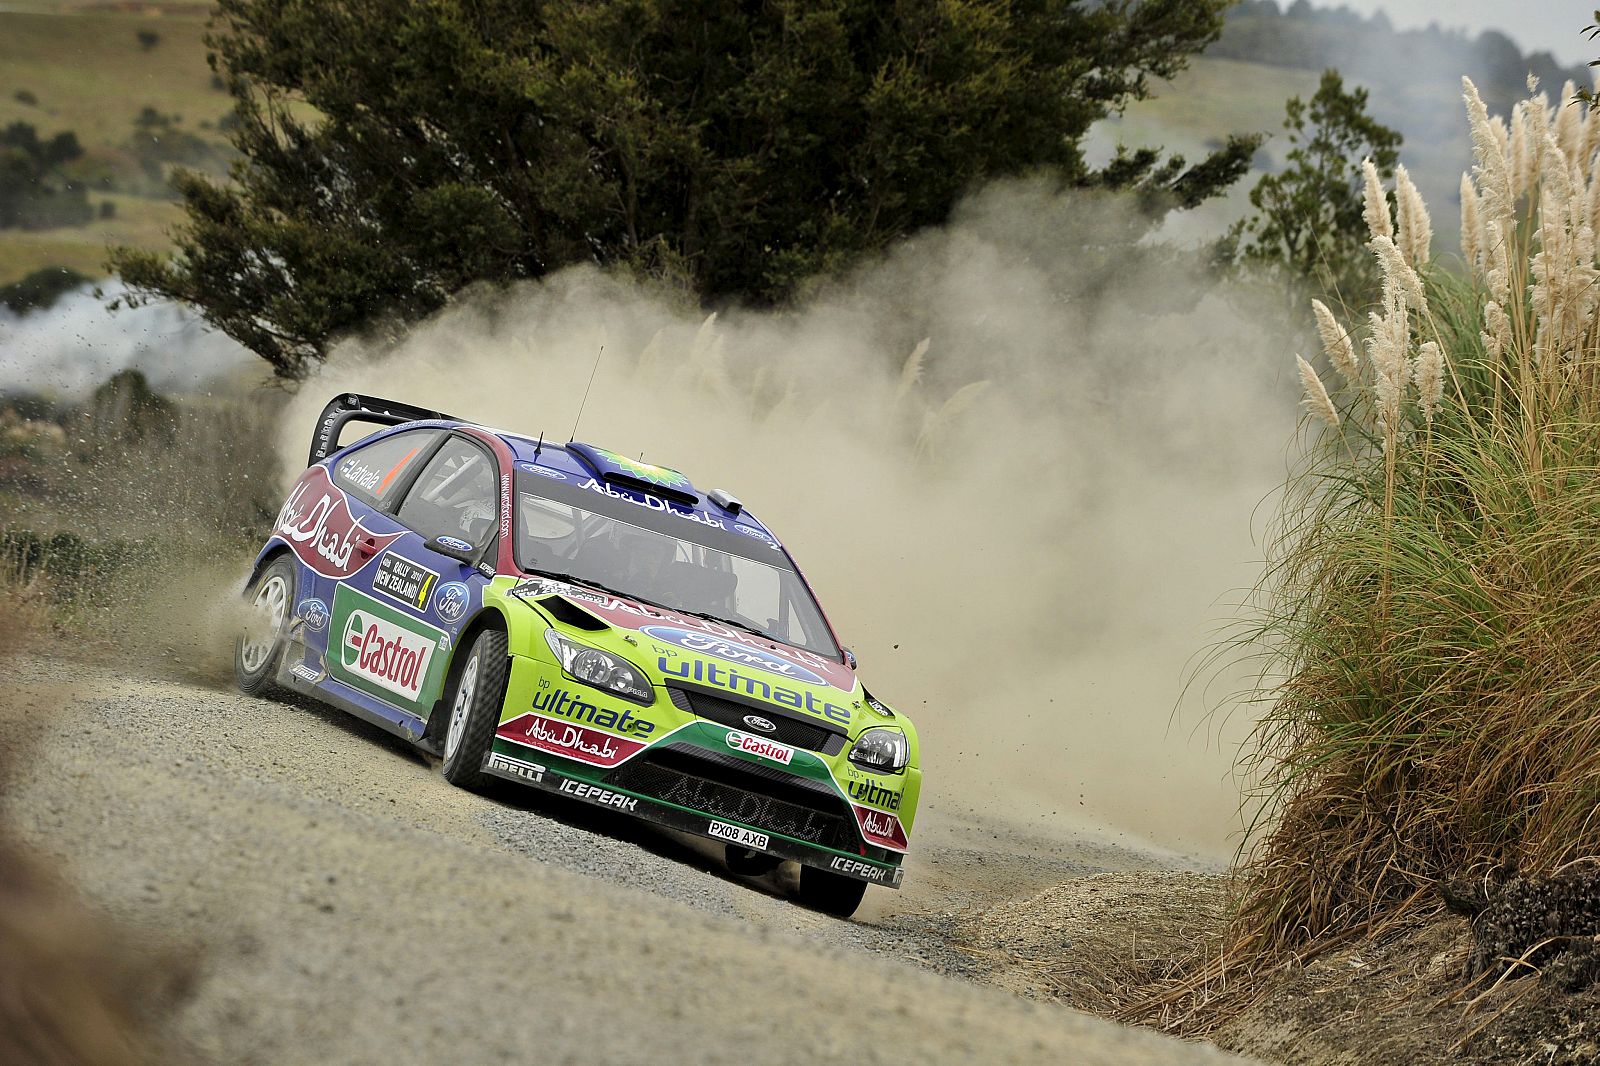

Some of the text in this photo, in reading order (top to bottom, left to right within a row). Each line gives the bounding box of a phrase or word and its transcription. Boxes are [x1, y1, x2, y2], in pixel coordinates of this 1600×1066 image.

[345, 459, 380, 489] Latvala
[529, 466, 558, 479] Ford
[644, 494, 728, 531] Dhabi
[294, 493, 366, 572] Dhabi
[442, 537, 468, 549] Ford
[375, 569, 418, 599] NEW ZEALAND
[392, 561, 411, 577] RALLY
[418, 574, 434, 609] 4
[439, 586, 464, 617] Ford
[305, 602, 323, 627] Ford
[360, 624, 427, 692] Castrol
[651, 644, 678, 658] bp
[680, 632, 798, 676] Ford
[538, 676, 551, 690] bp
[658, 657, 851, 725] ultimate
[532, 689, 656, 738] ultimate
[750, 716, 772, 730] Ford
[562, 725, 620, 759] Dhabi
[742, 736, 791, 763] Castrol
[487, 751, 546, 782] PIRELLI
[847, 766, 860, 780] bp
[559, 777, 639, 812] ICEPEAK
[710, 821, 768, 848] PX08 AXB
[830, 856, 887, 882] ICEPEAK
